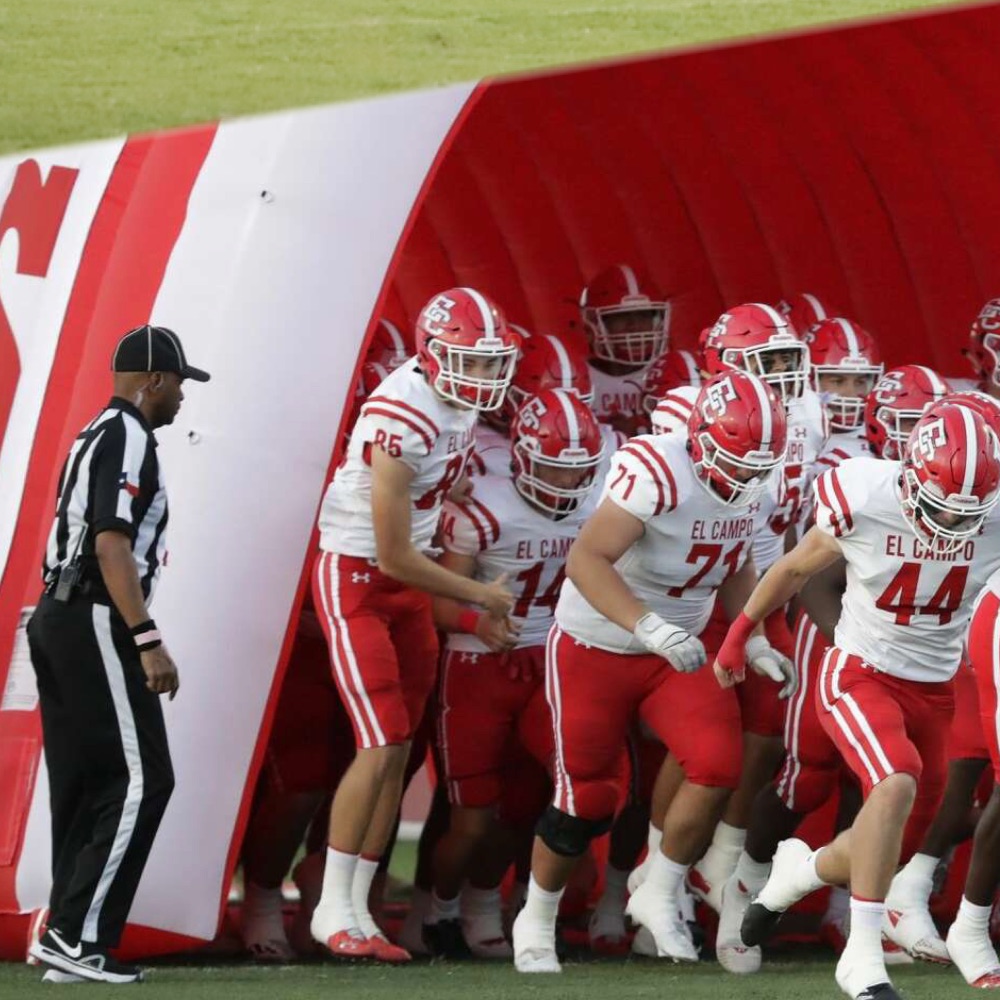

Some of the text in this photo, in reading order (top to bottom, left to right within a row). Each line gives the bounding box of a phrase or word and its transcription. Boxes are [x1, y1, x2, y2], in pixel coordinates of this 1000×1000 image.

[610, 463, 637, 501] 71
[692, 519, 753, 539] EL CAMPO
[516, 538, 576, 559] EL CAM
[886, 535, 975, 562] EL CAMPO
[666, 541, 745, 598] 71
[876, 562, 969, 626] 44
